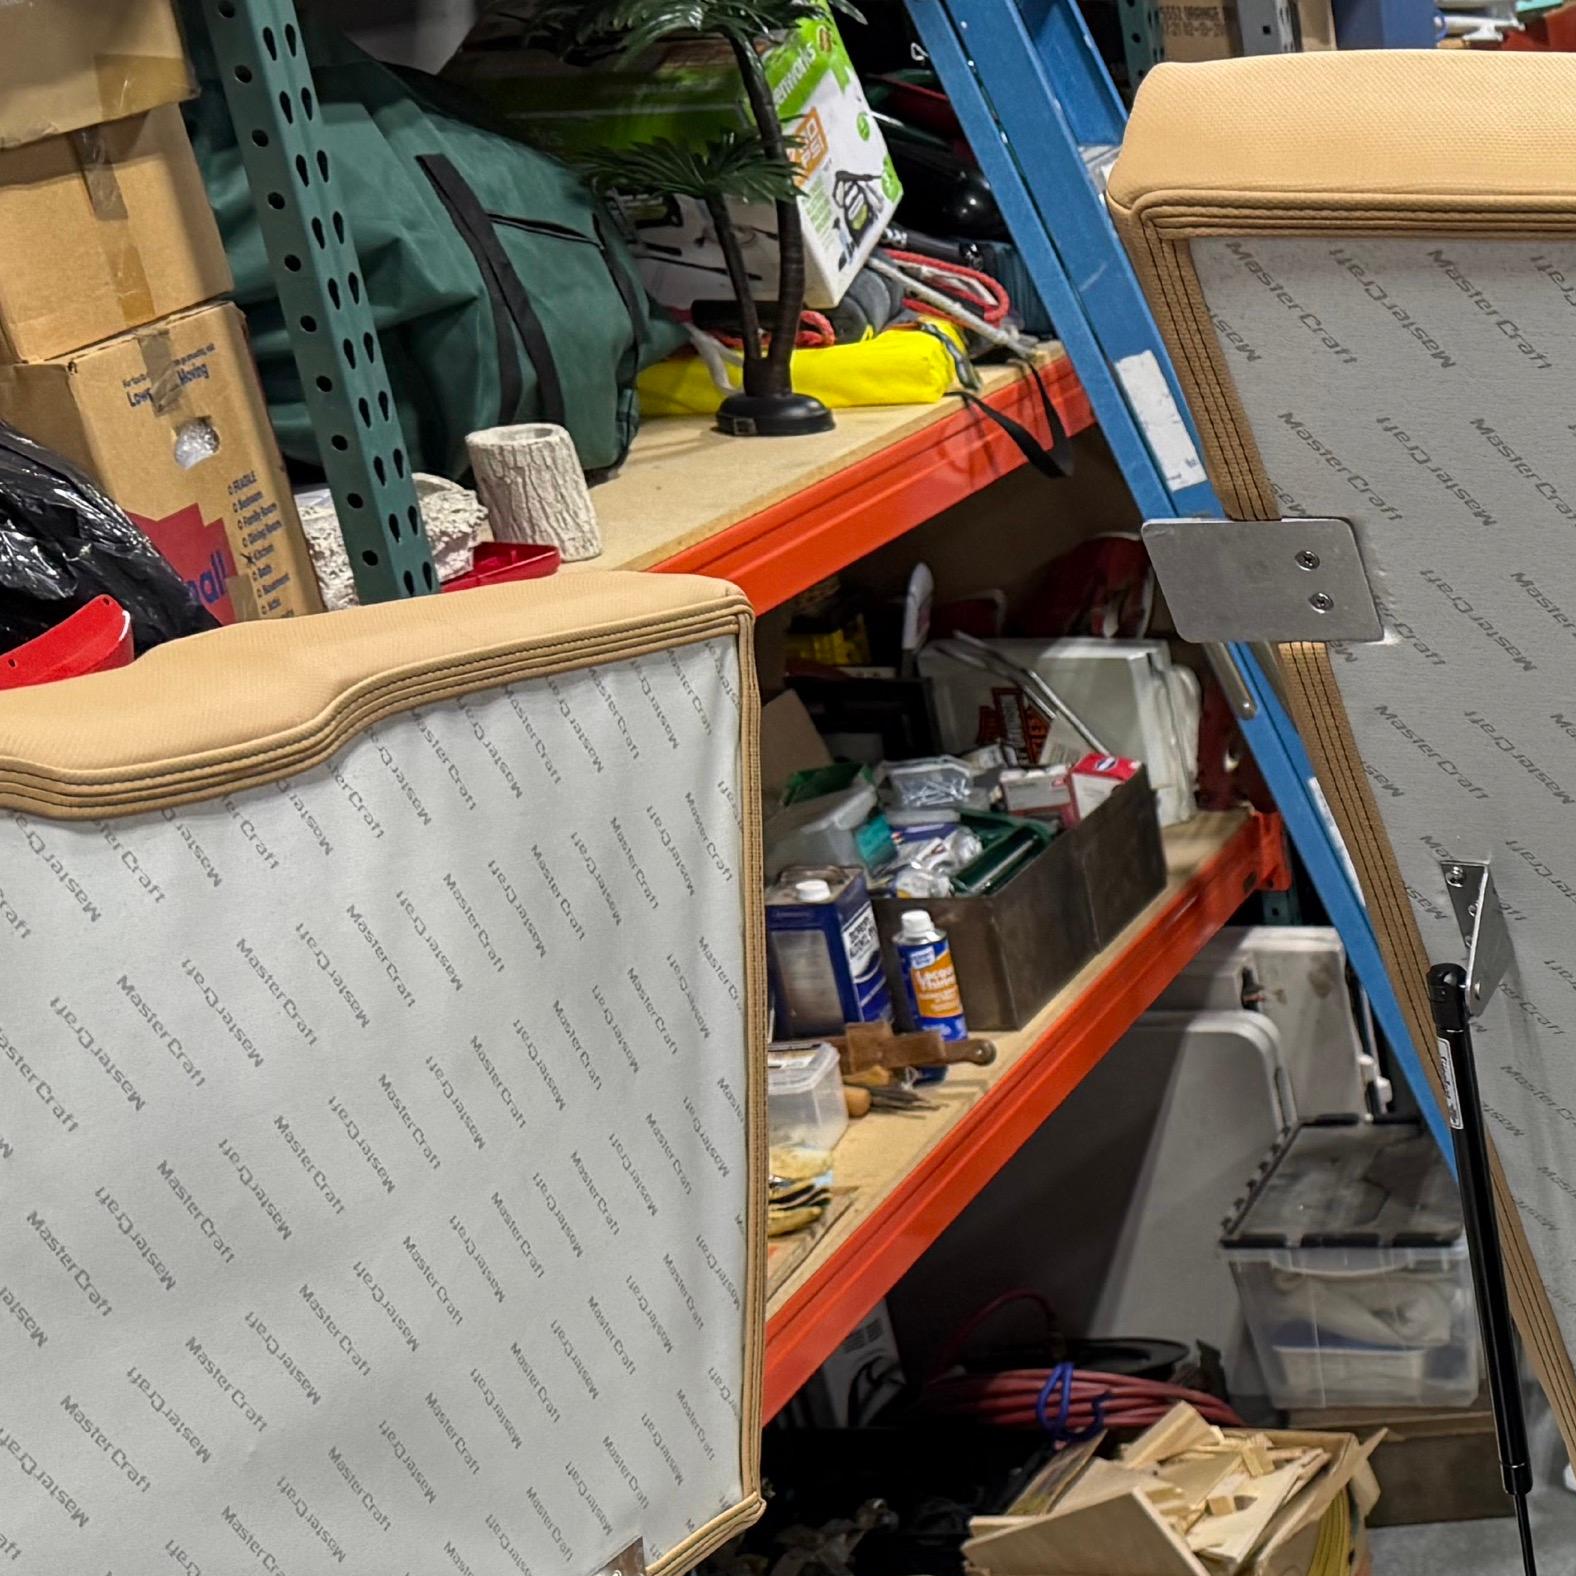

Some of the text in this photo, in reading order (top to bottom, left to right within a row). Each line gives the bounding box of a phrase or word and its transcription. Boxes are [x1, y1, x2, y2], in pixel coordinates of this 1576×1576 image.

[176, 363, 209, 385] Moving
[1276, 410, 1405, 523] MasterCraft
[180, 957, 266, 1069] MasterCraft
[293, 921, 372, 1030] MasterCraft
[48, 995, 148, 1113] MasterCraft
[217, 1137, 294, 1242] MasterCraft
[24, 1209, 114, 1318] MasterCraft
[58, 1393, 152, 1494] MasterCraft
